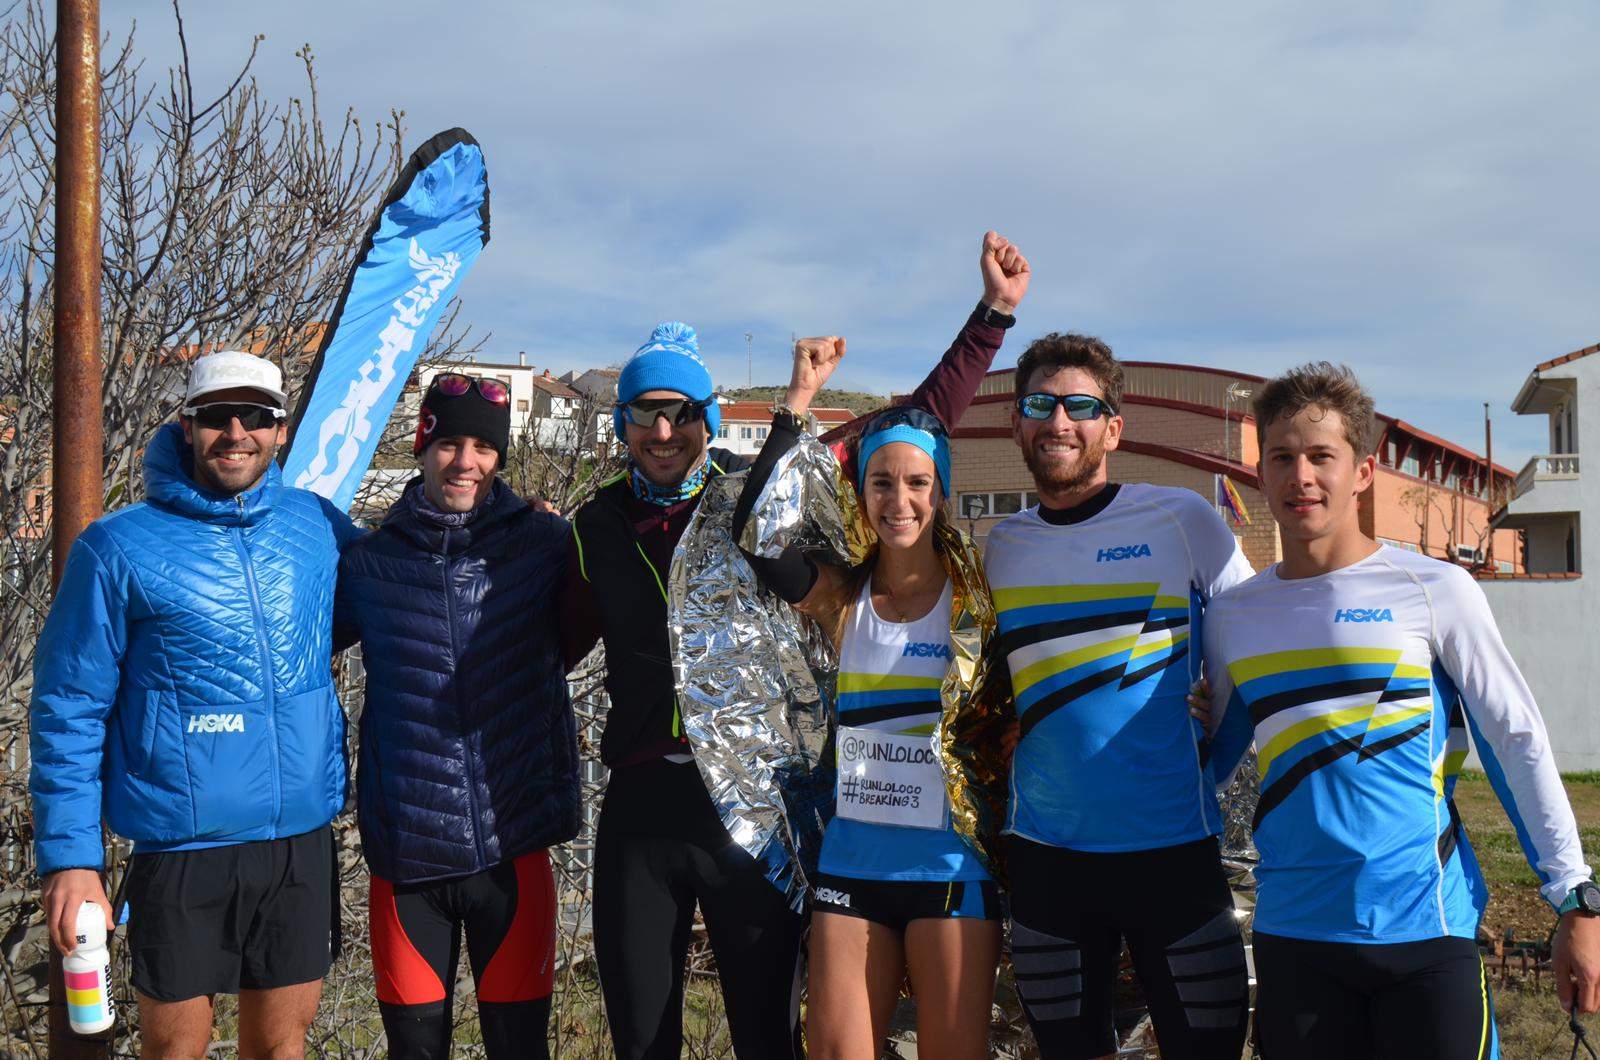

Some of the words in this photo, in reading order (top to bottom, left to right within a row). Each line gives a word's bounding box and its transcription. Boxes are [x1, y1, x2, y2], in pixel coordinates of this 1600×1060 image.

[1096, 543, 1152, 562] HOKA
[1334, 608, 1393, 623] HOKA
[902, 642, 952, 659] HOKA
[187, 713, 245, 733] HOKA
[843, 736, 938, 765] @RUNLOLOC
